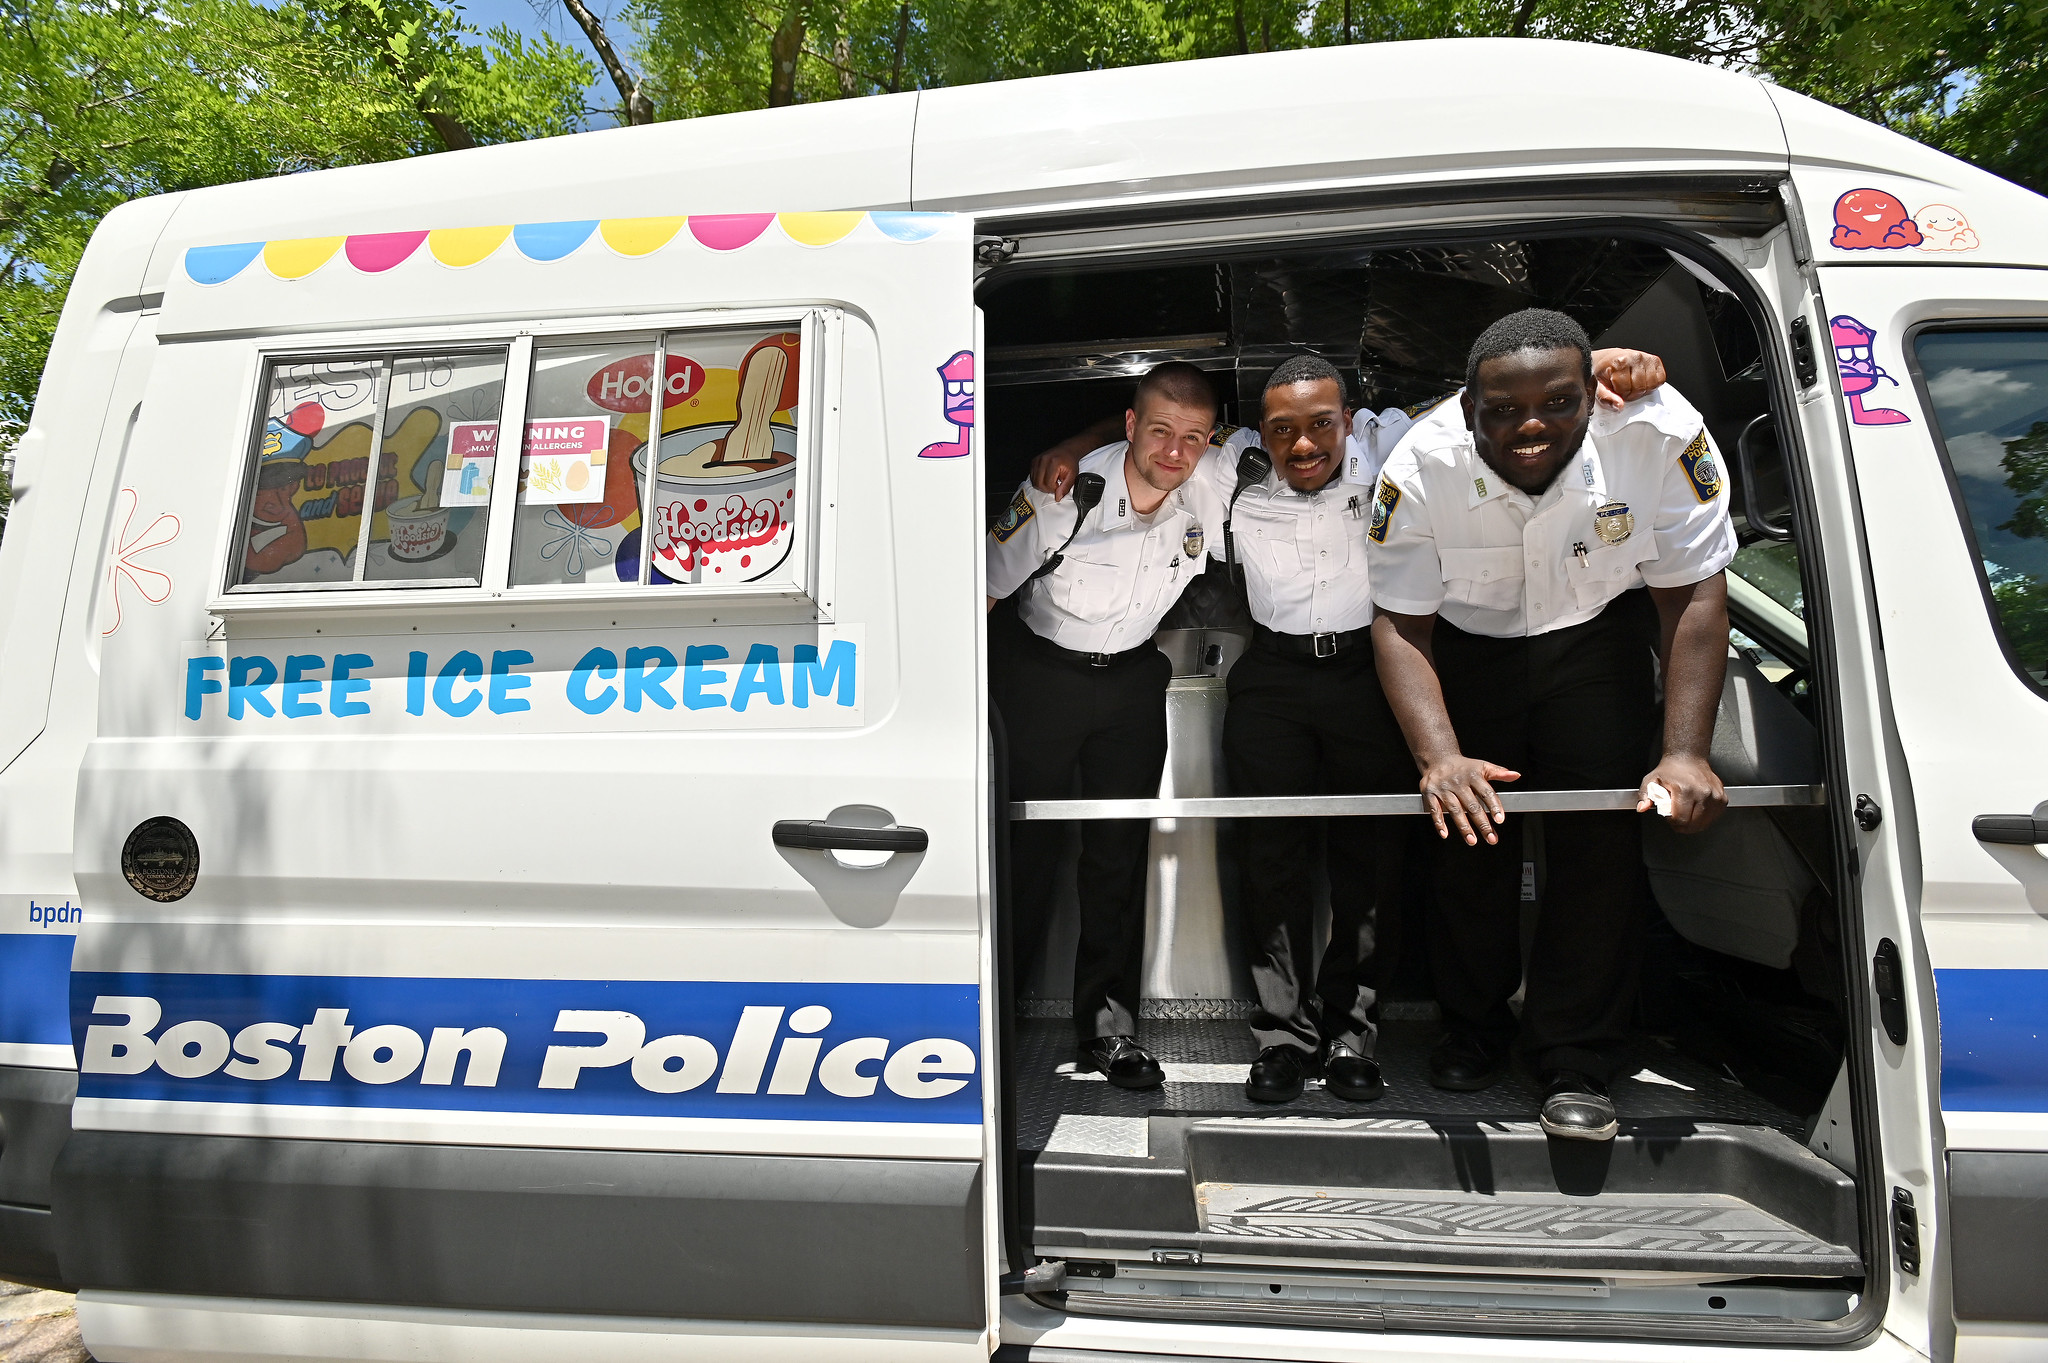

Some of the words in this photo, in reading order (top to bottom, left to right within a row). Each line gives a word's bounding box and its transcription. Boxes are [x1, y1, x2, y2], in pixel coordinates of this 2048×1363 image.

[471, 445, 492, 453] MAY
[532, 441, 584, 450] ALLERGENS
[472, 426, 585, 442] WNING
[394, 521, 442, 551] Hoodsie
[653, 494, 778, 562] Hoodsie
[185, 654, 375, 721] FREE
[405, 649, 535, 718] ICE
[566, 639, 857, 716] CREAM
[30, 900, 83, 928] bpdn
[80, 995, 508, 1087] Boston
[537, 1005, 977, 1100] Police
